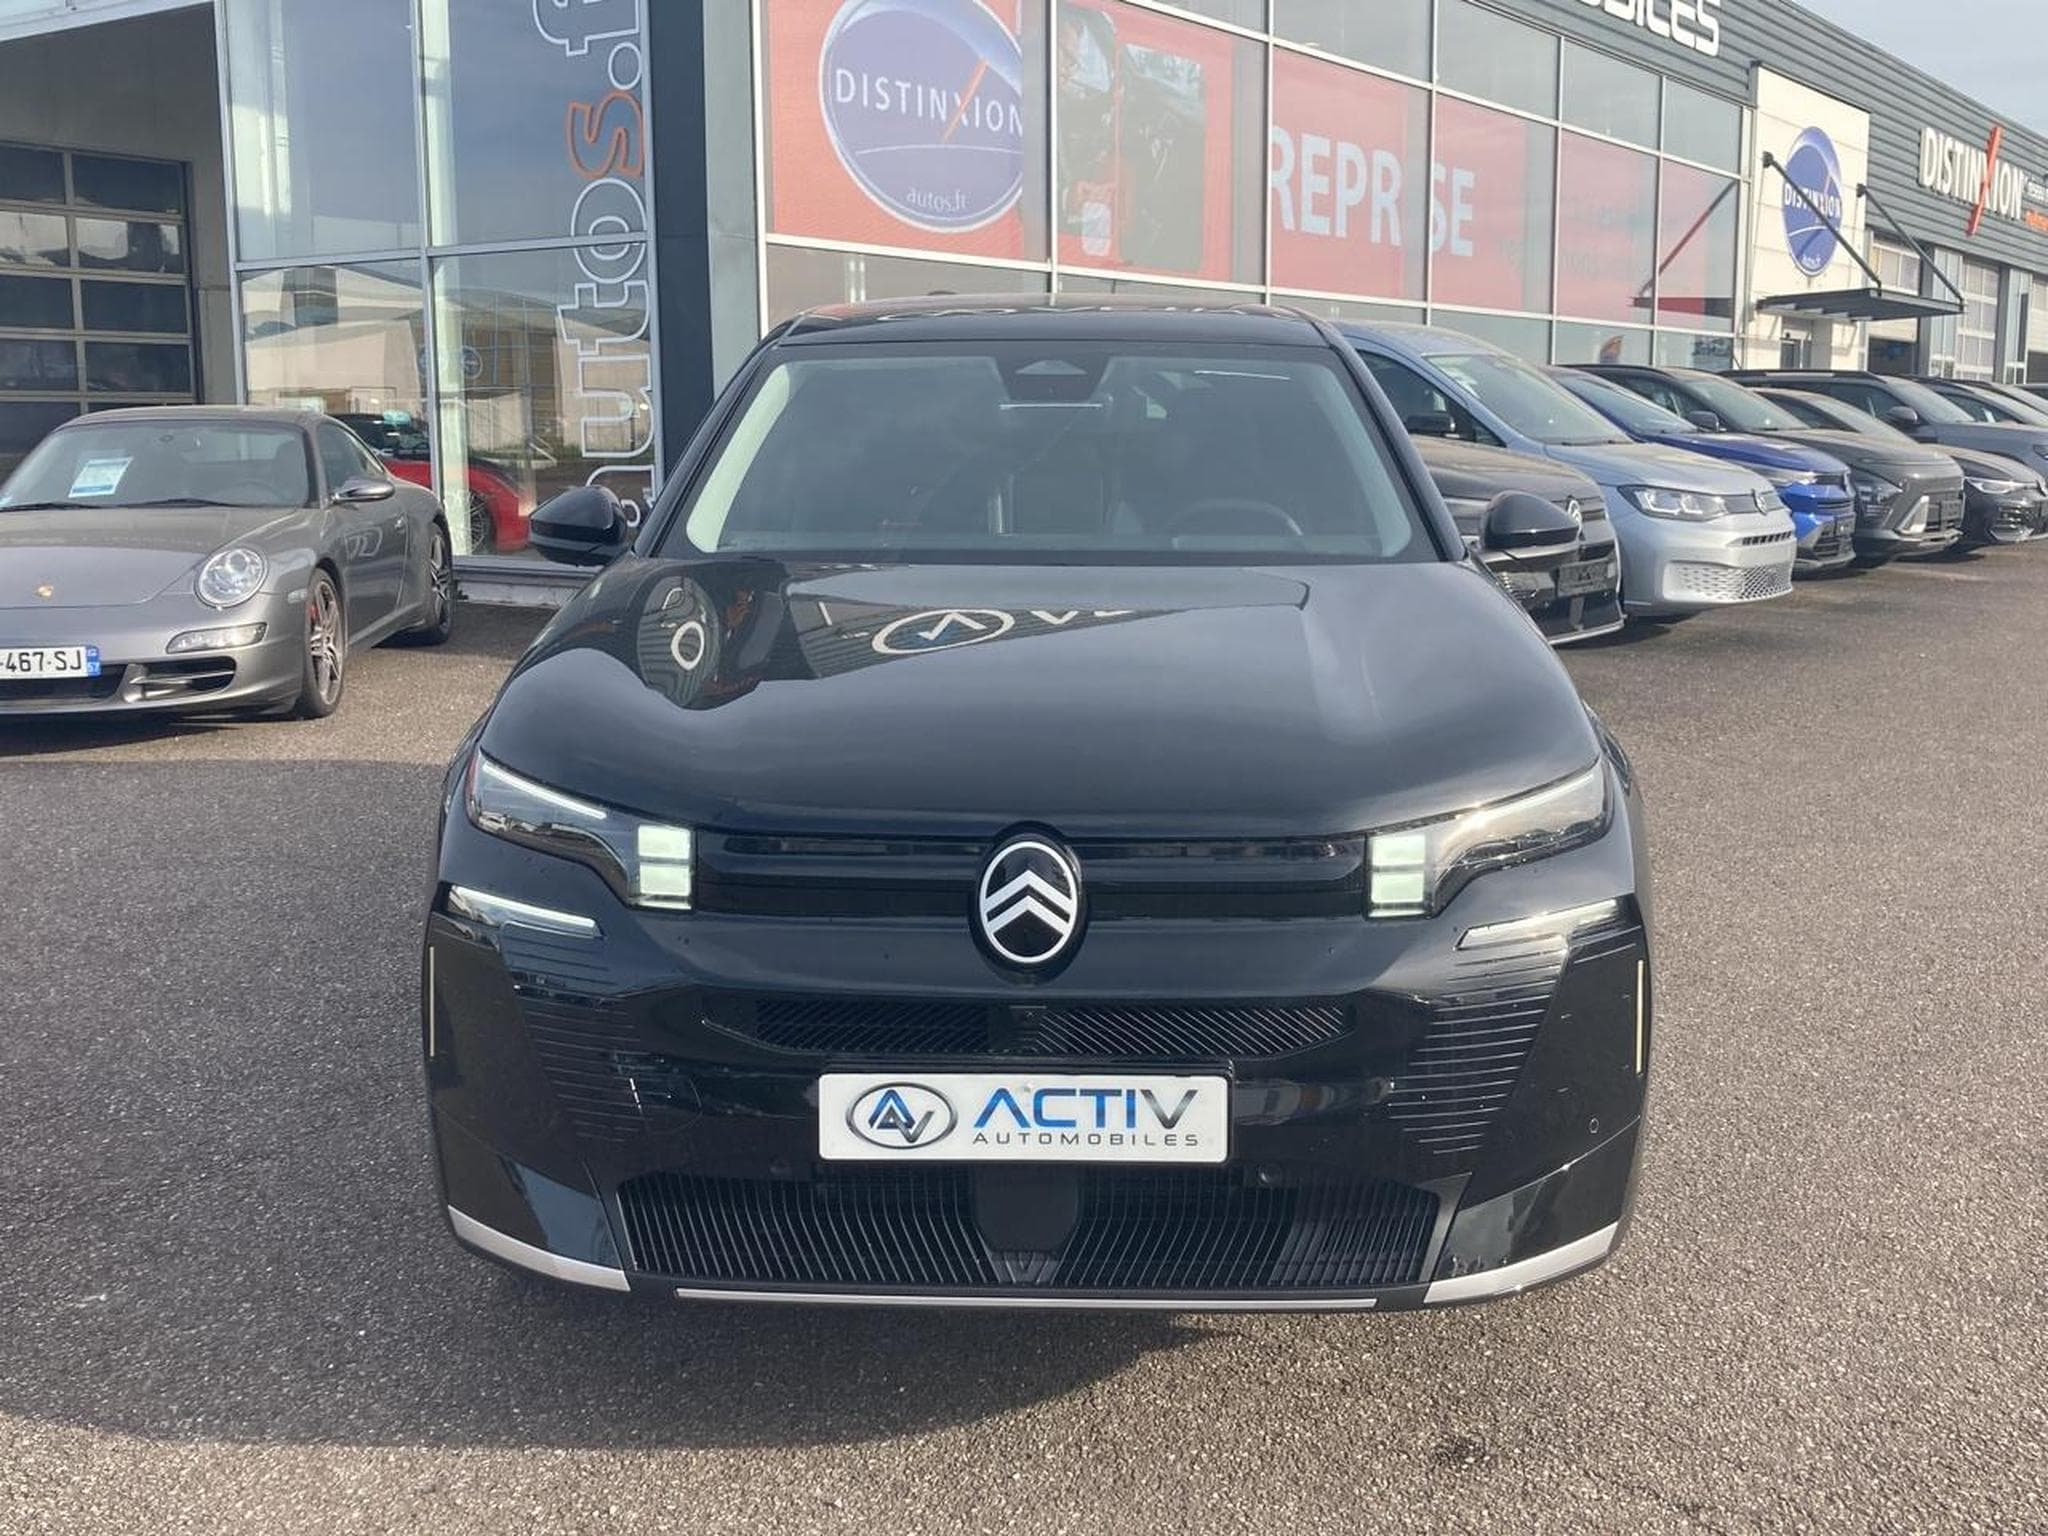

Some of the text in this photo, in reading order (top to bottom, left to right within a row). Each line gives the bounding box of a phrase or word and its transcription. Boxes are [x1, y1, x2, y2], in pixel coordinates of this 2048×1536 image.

[1920, 127, 2025, 236] DISTINXION
[974, 1087, 1198, 1129] ACTIV
[972, 1132, 1198, 1146] AUTOMOBILES
